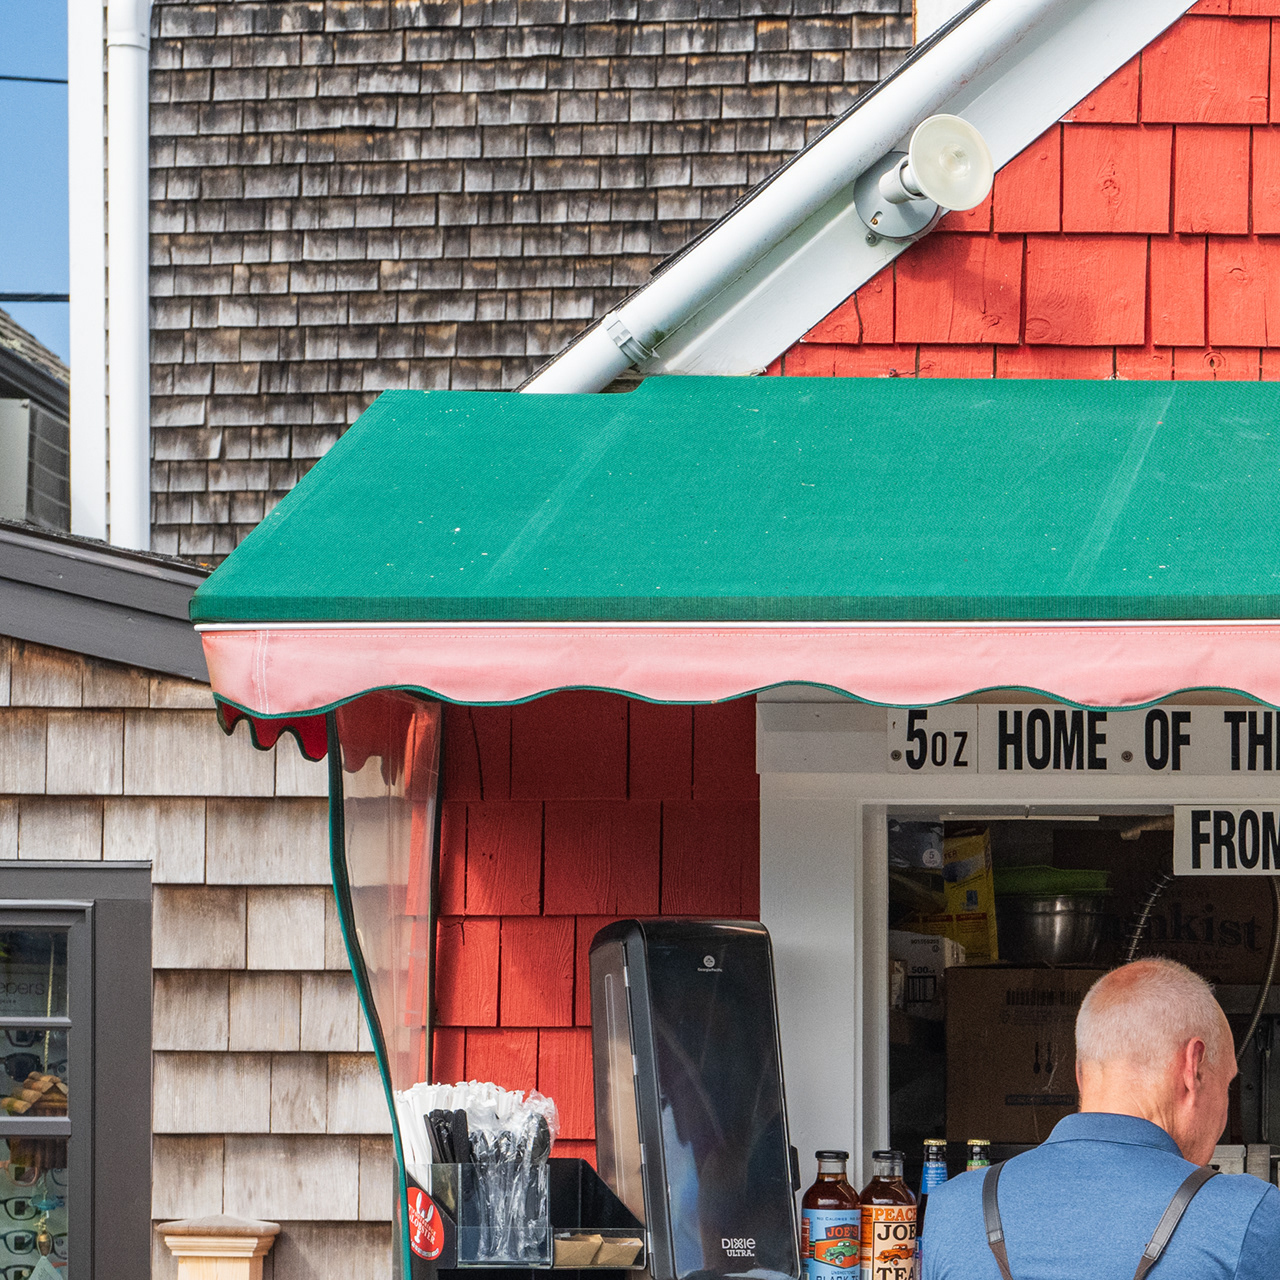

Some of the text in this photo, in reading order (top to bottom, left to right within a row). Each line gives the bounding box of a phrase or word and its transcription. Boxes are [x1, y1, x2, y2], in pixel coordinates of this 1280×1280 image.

[999, 709, 1107, 770] HOME
[1145, 709, 1191, 770] OF
[827, 1225, 858, 1238] JOE'S
